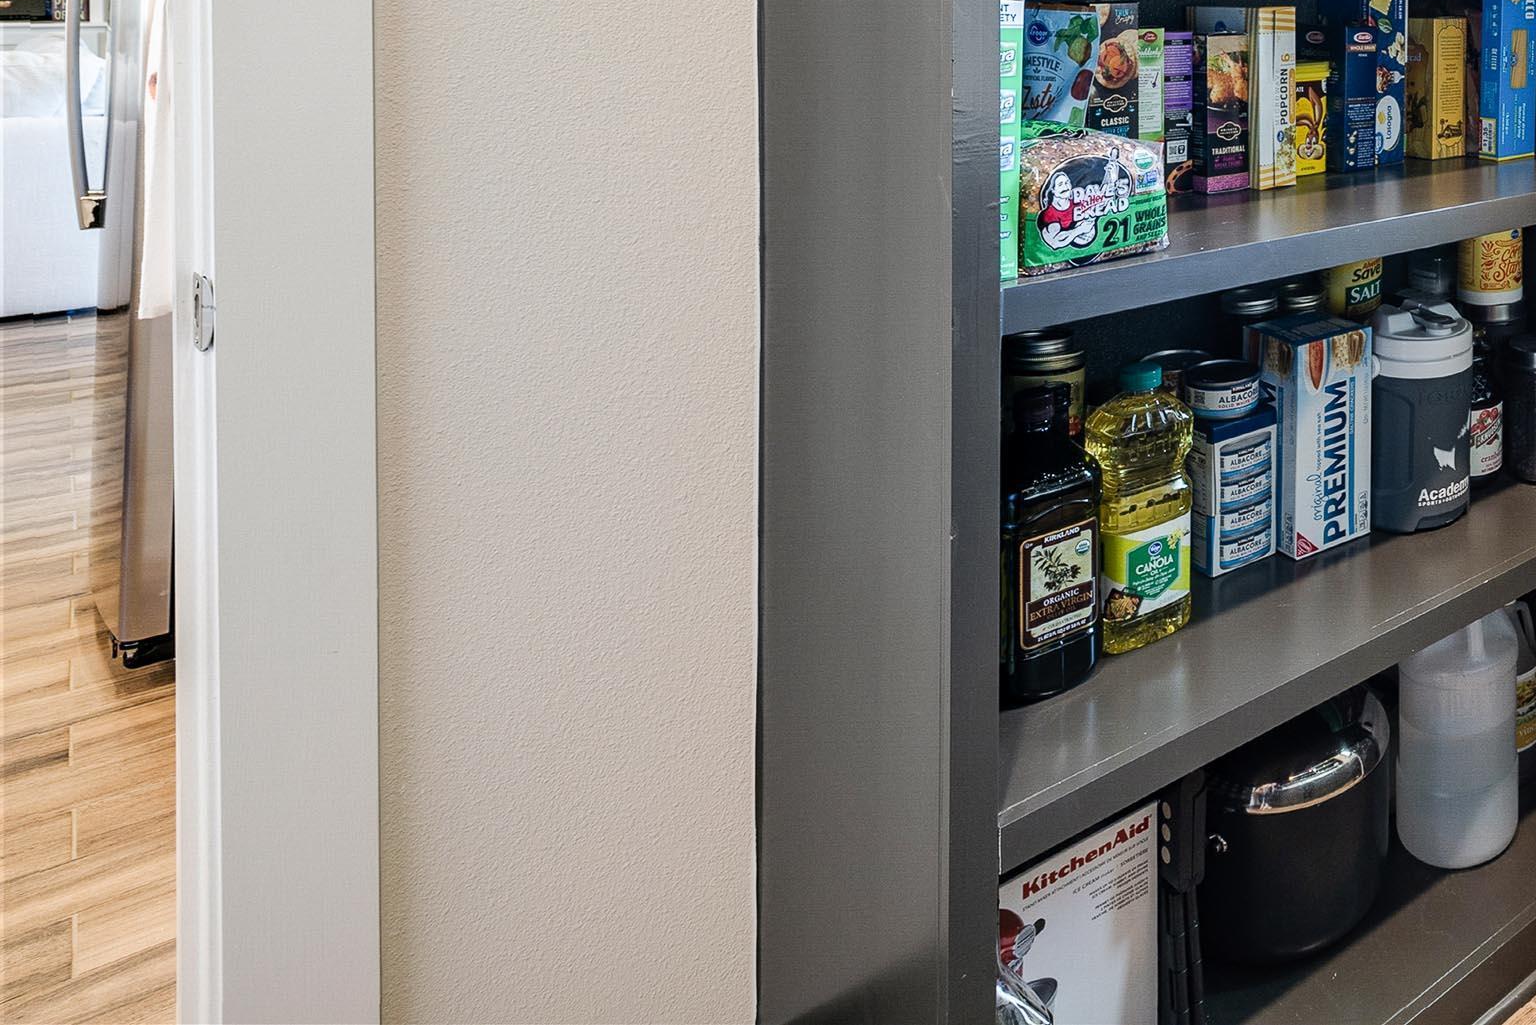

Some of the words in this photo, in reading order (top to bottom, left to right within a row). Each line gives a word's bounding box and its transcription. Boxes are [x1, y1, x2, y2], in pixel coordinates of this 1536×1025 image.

[1115, 15, 1135, 25] Crispy
[1281, 53, 1290, 63] 6
[1022, 82, 1056, 111] Zesty
[1280, 68, 1288, 125] POPCORN
[1101, 116, 1130, 128] CLASSIC
[1212, 144, 1245, 156] TRADITIONAL
[1073, 177, 1129, 203] DAVE'S
[1073, 198, 1129, 222] BREAD
[1135, 204, 1166, 222] WHOLE
[1102, 215, 1131, 248] 21
[1133, 217, 1166, 235] GRAINS
[1147, 229, 1164, 238] SEEDS
[1352, 264, 1381, 283] Save
[1350, 280, 1382, 304] SALT
[1236, 399, 1251, 407] WHITE
[1314, 437, 1322, 449] with
[1230, 450, 1262, 467] ALBACORE
[1324, 380, 1348, 545] PREMIUM
[1230, 480, 1262, 497] ALBACORE
[1306, 473, 1327, 522] original
[1230, 509, 1262, 525] ALBACORE
[1044, 526, 1080, 544] KIRKLAND
[1229, 539, 1262, 556] ALBACORE
[1136, 554, 1174, 575] CANOLA
[1030, 603, 1058, 621] EXTRA
[1060, 590, 1093, 610] VIRGIN
[1043, 588, 1080, 607] ORGANIC
[1022, 816, 1151, 901] KitchenAid
[1072, 887, 1082, 895] ICE
[1082, 878, 1100, 891] CREAM
